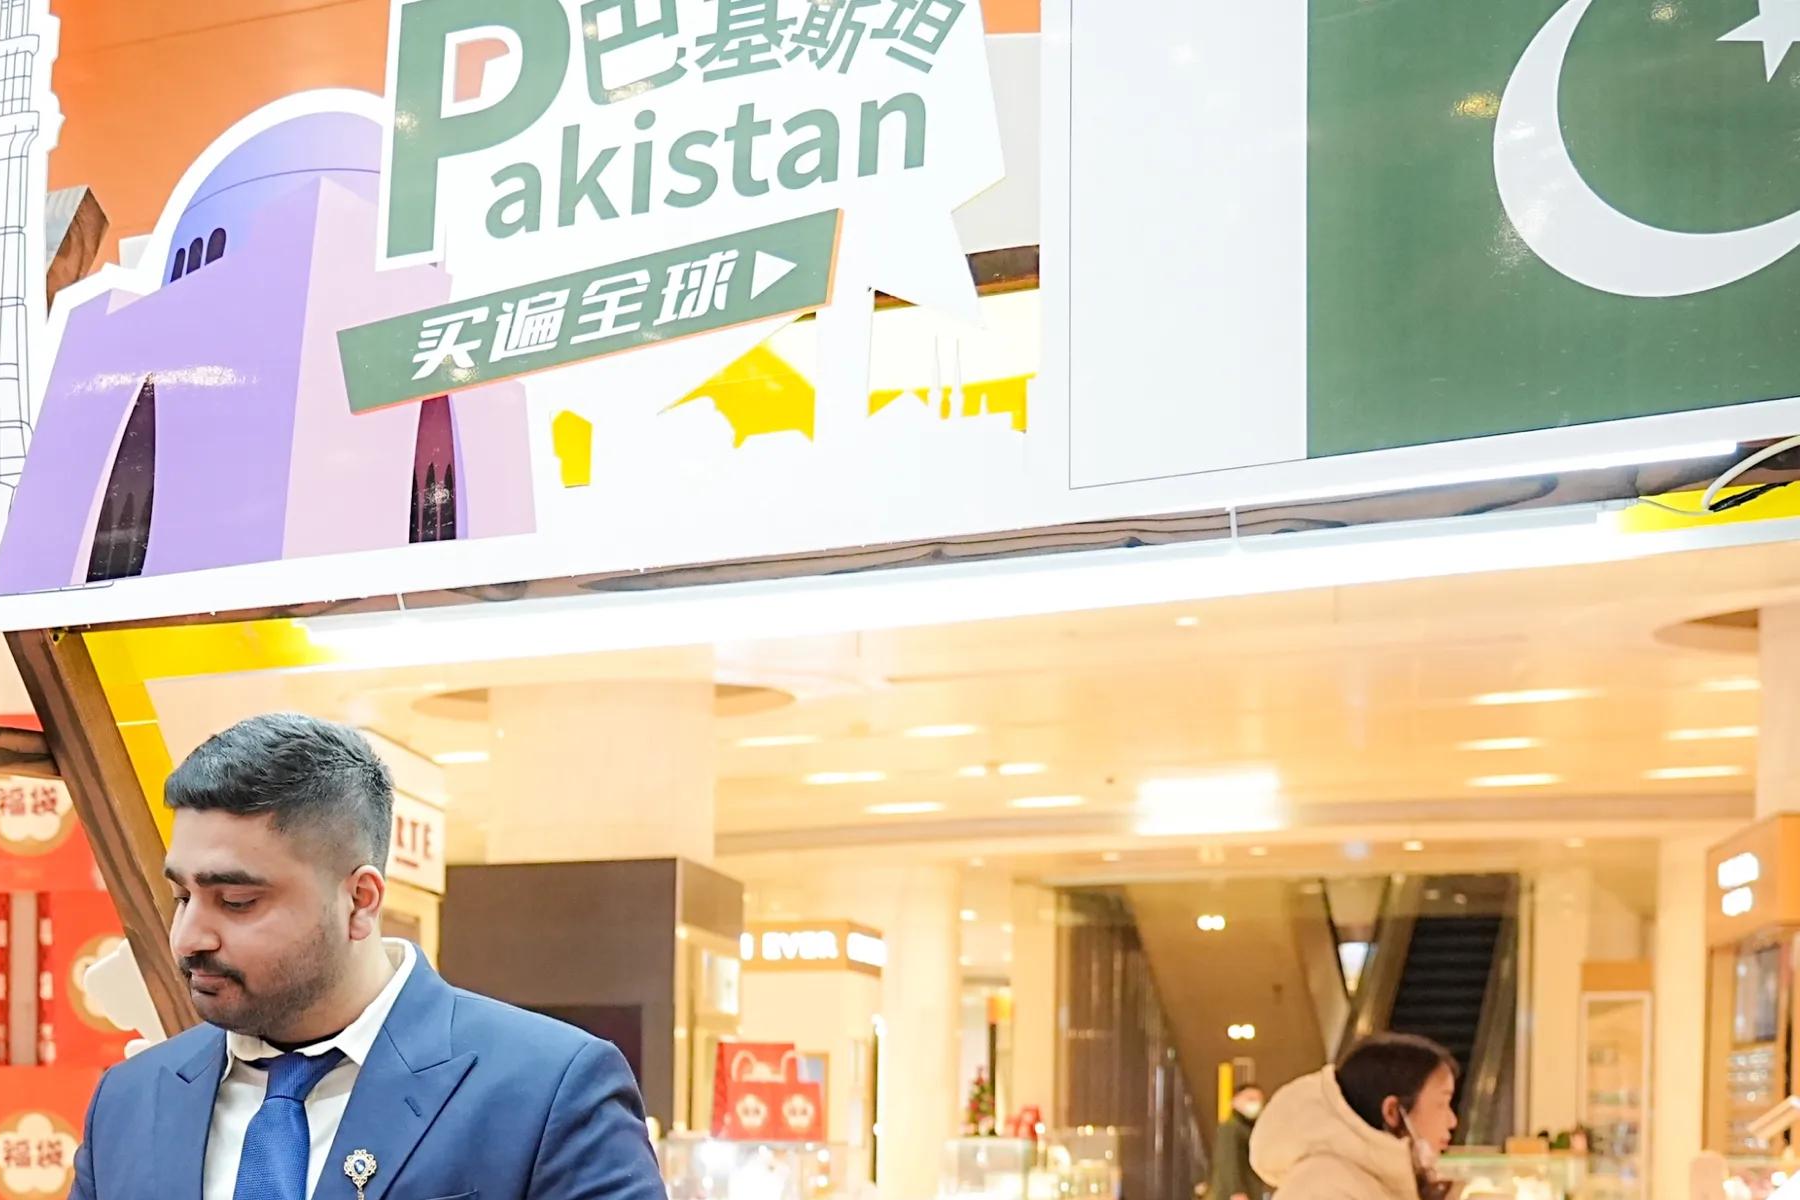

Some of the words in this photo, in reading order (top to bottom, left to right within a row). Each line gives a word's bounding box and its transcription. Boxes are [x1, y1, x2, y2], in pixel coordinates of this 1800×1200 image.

[580, 0, 966, 105] 巴基斯坦
[387, 0, 927, 259] Pakistan
[412, 249, 738, 380] 买遍全球
